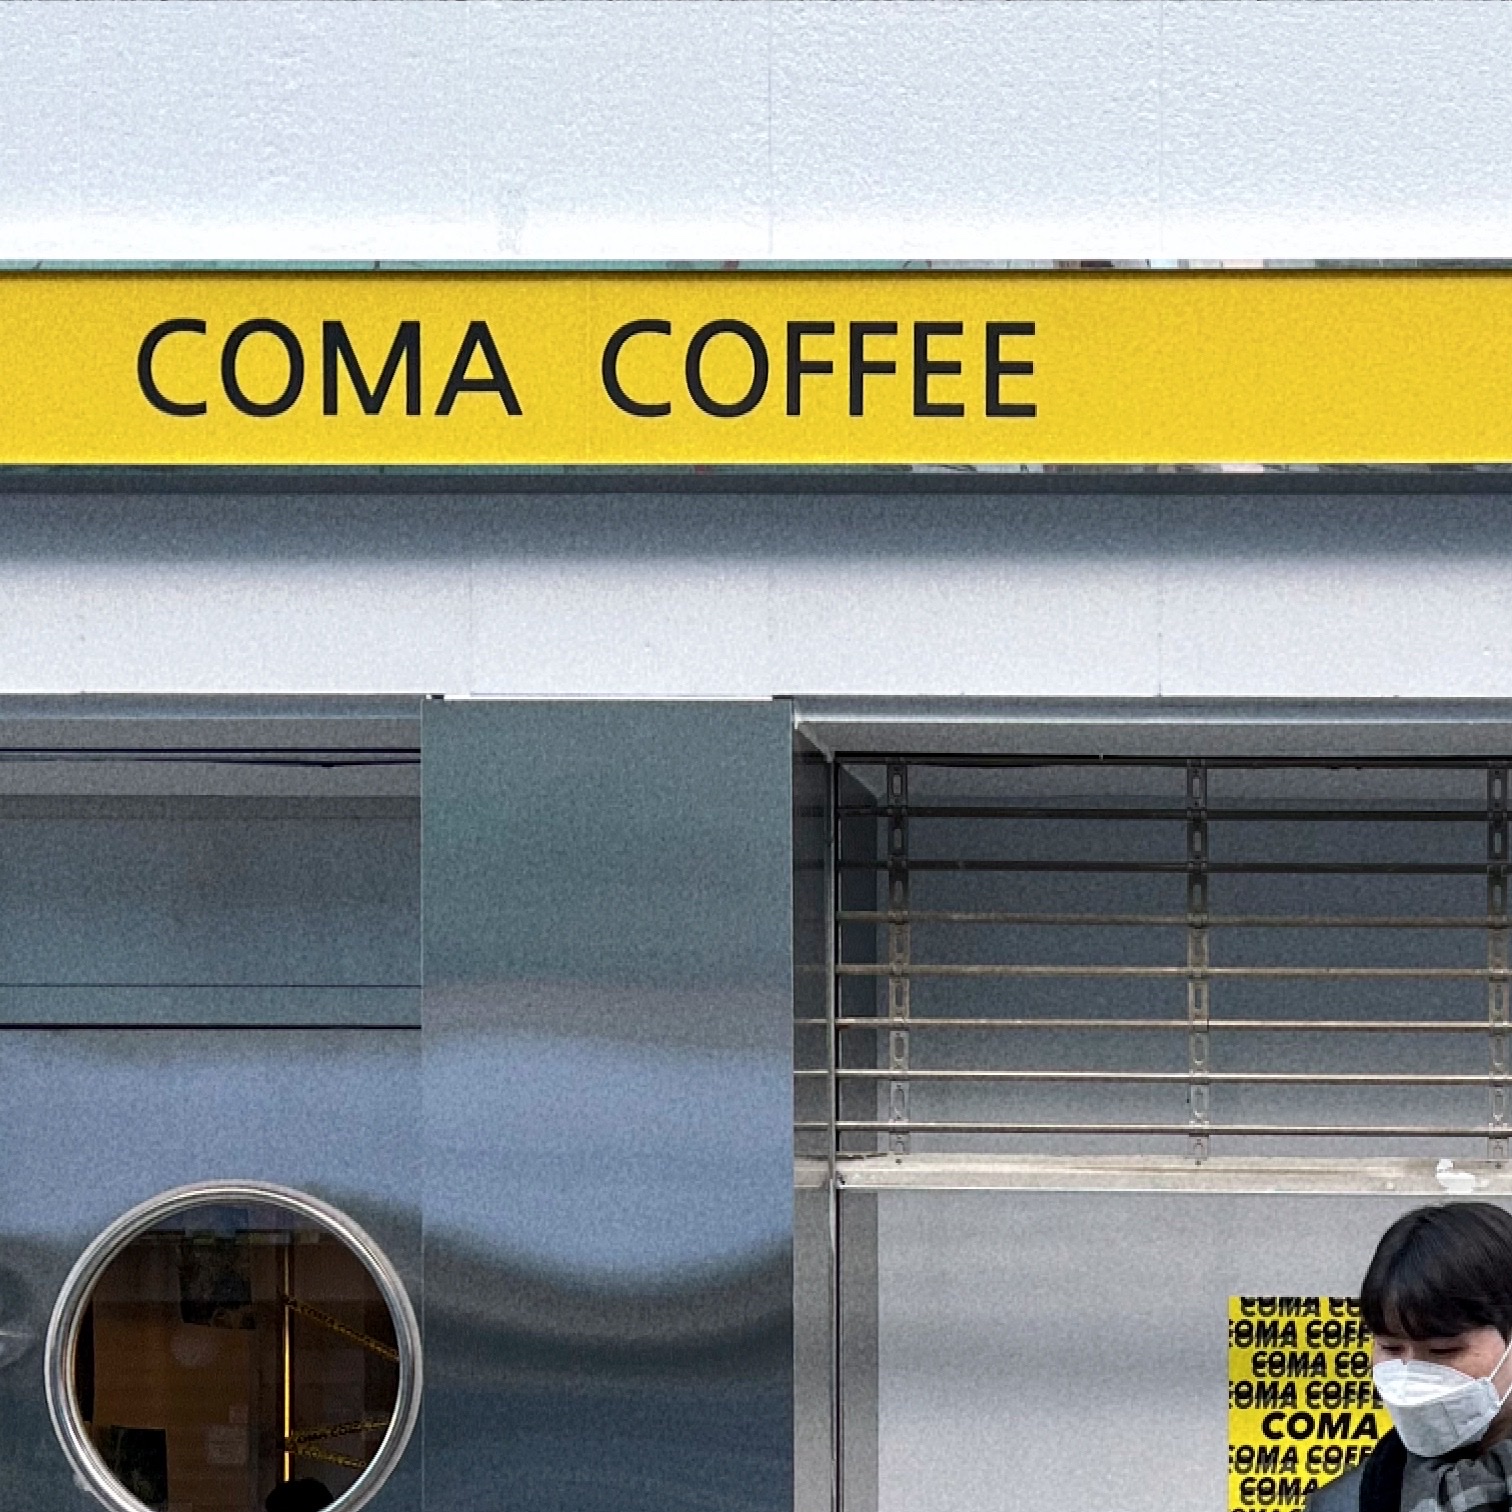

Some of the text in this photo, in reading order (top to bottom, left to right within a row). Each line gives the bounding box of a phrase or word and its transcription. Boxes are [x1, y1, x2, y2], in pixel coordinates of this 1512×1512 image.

[137, 318, 1036, 417] COMA COFFEE
[1251, 1350, 1327, 1378] COMA
[1261, 1410, 1378, 1440] COMA
